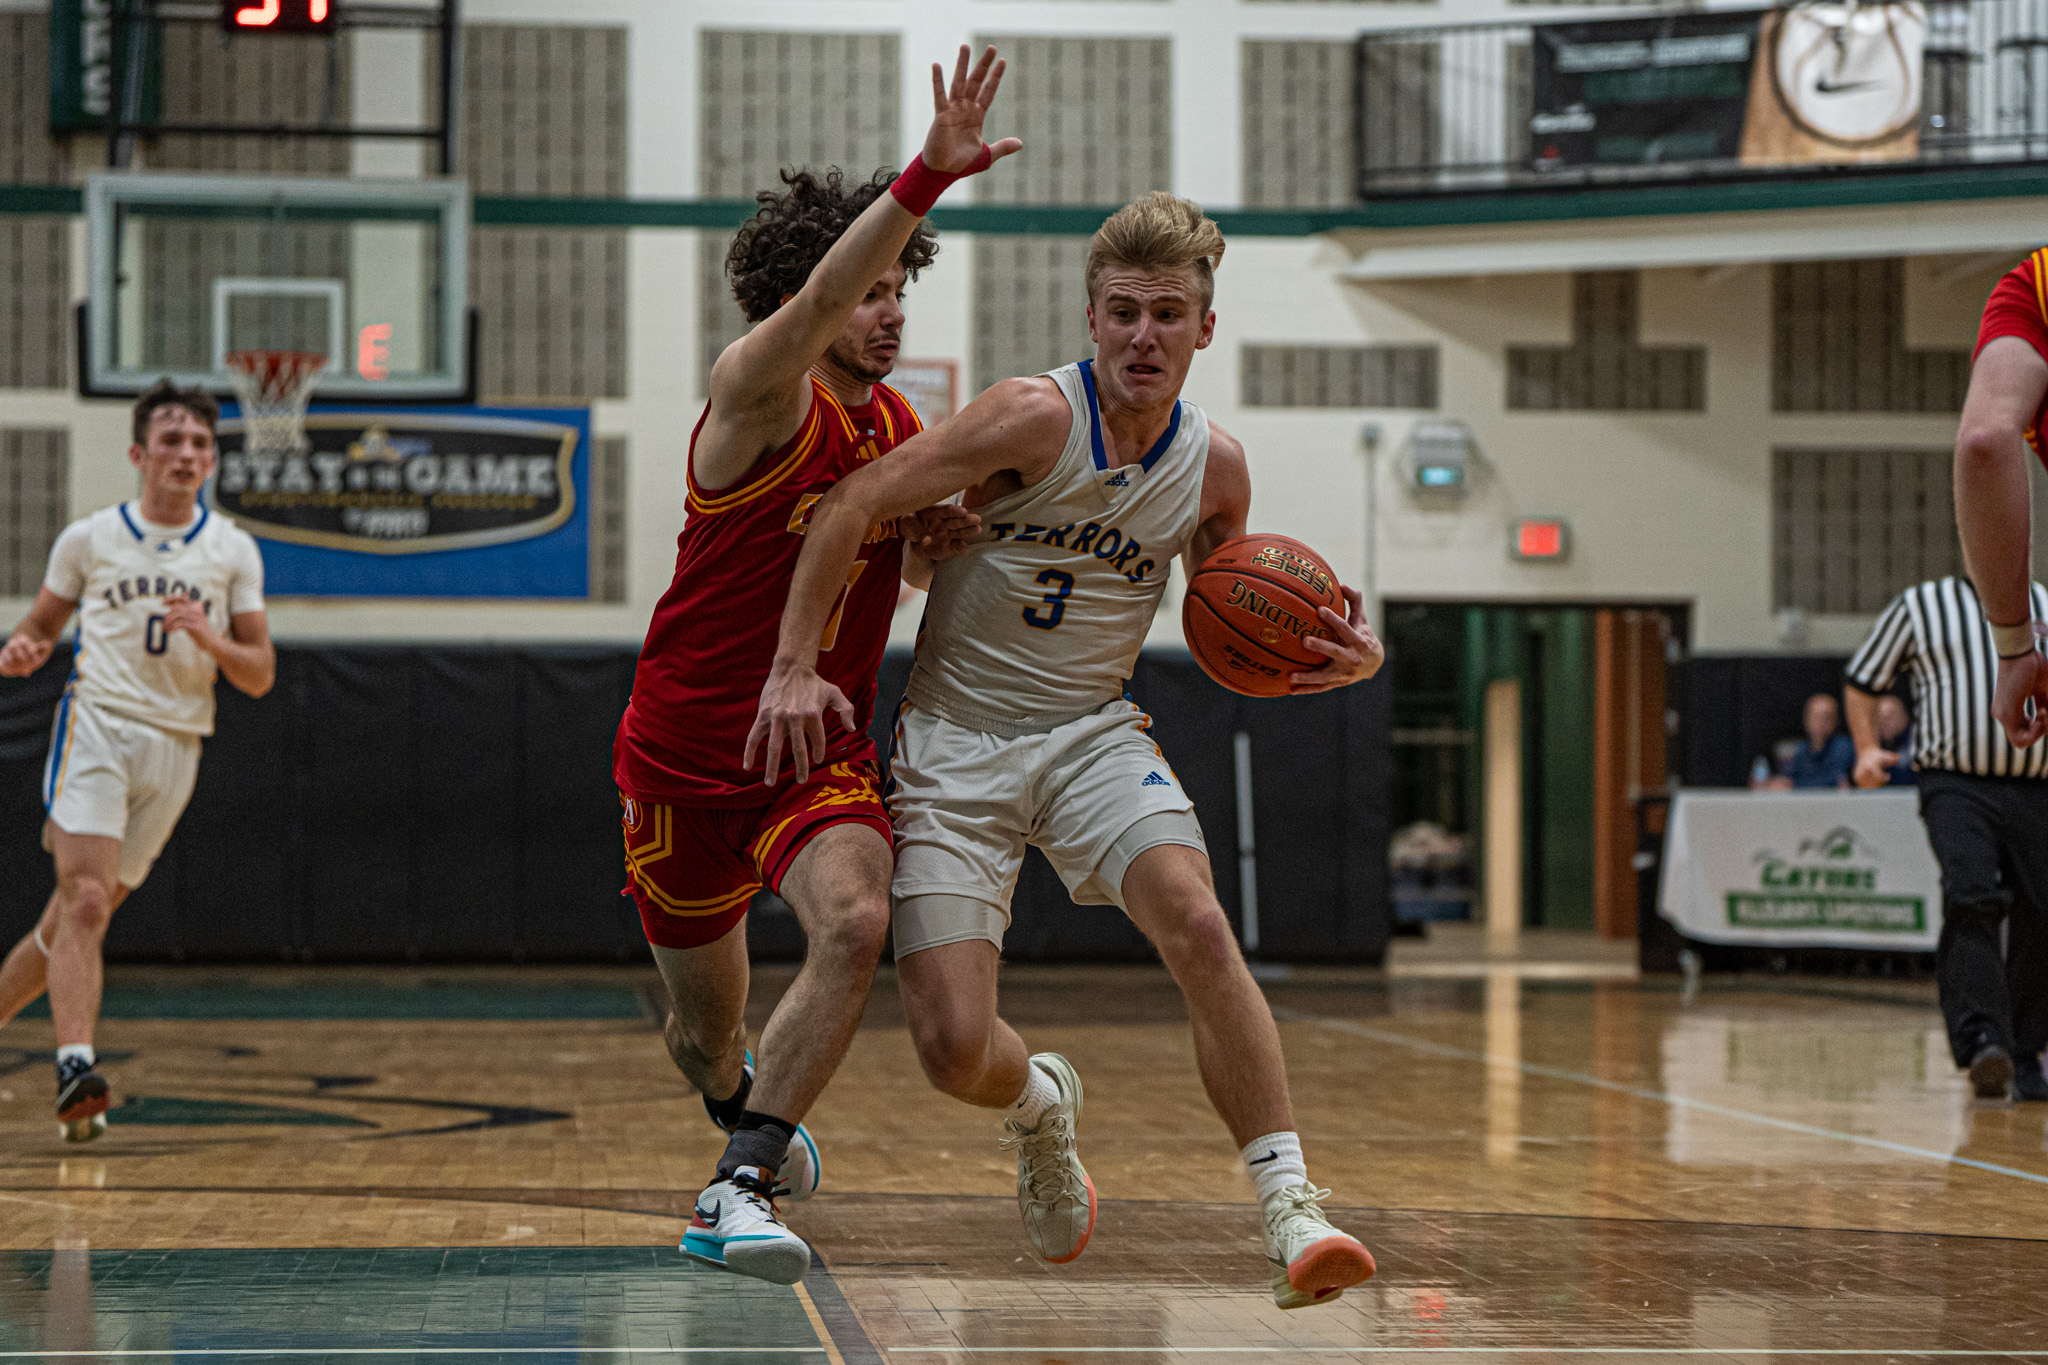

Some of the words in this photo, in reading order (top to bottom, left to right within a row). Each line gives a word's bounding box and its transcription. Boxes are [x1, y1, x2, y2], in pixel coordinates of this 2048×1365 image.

[990, 521, 1155, 583] TERRORS
[104, 583, 211, 616] TERROR
[1021, 568, 1075, 632] 3
[1251, 553, 1335, 606] LEGACY
[146, 613, 168, 655] 0
